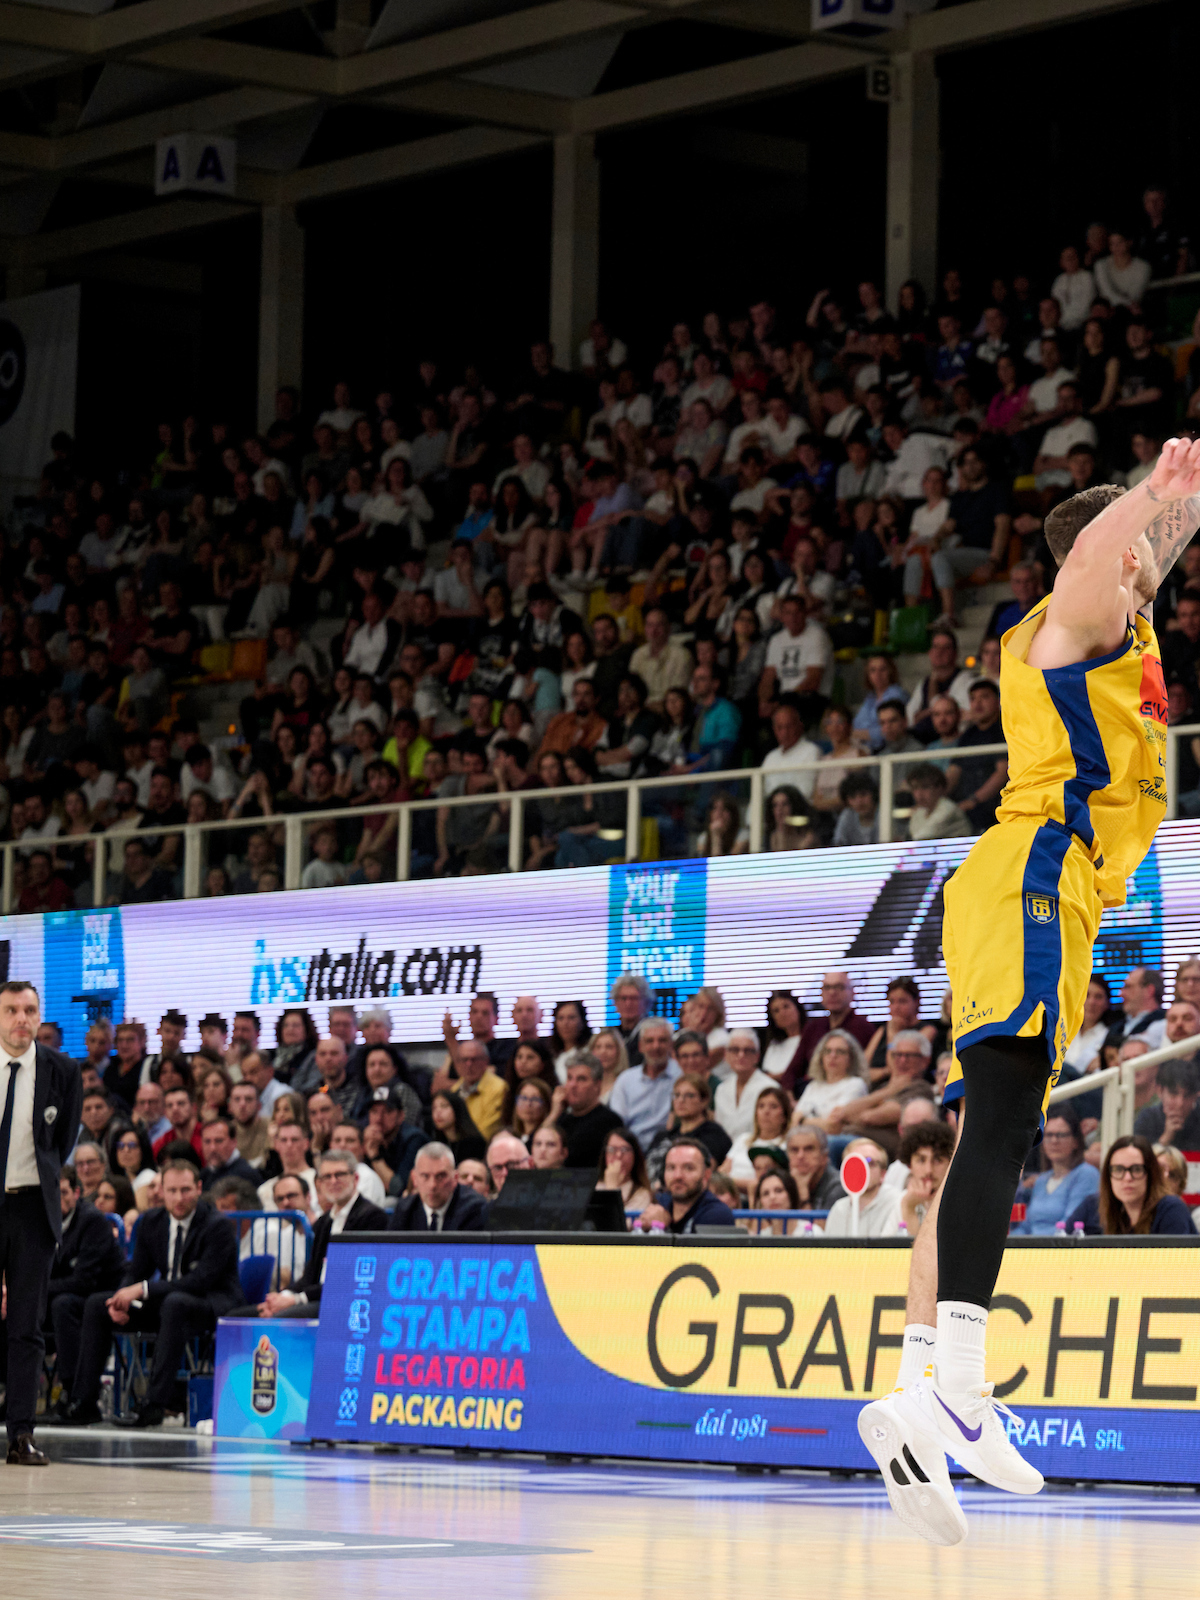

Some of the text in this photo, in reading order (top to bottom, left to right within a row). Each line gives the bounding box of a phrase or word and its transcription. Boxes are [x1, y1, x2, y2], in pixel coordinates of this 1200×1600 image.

[163, 144, 181, 183] A
[196, 145, 226, 183] A
[386, 1256, 538, 1303] GRAFICA
[378, 1303, 531, 1354] STAMPA
[374, 1352, 526, 1391] LEGATORIA
[369, 1391, 525, 1432] PACKAGING
[695, 1407, 769, 1442] dal 1981
[1094, 1428, 1126, 1452] SRL
